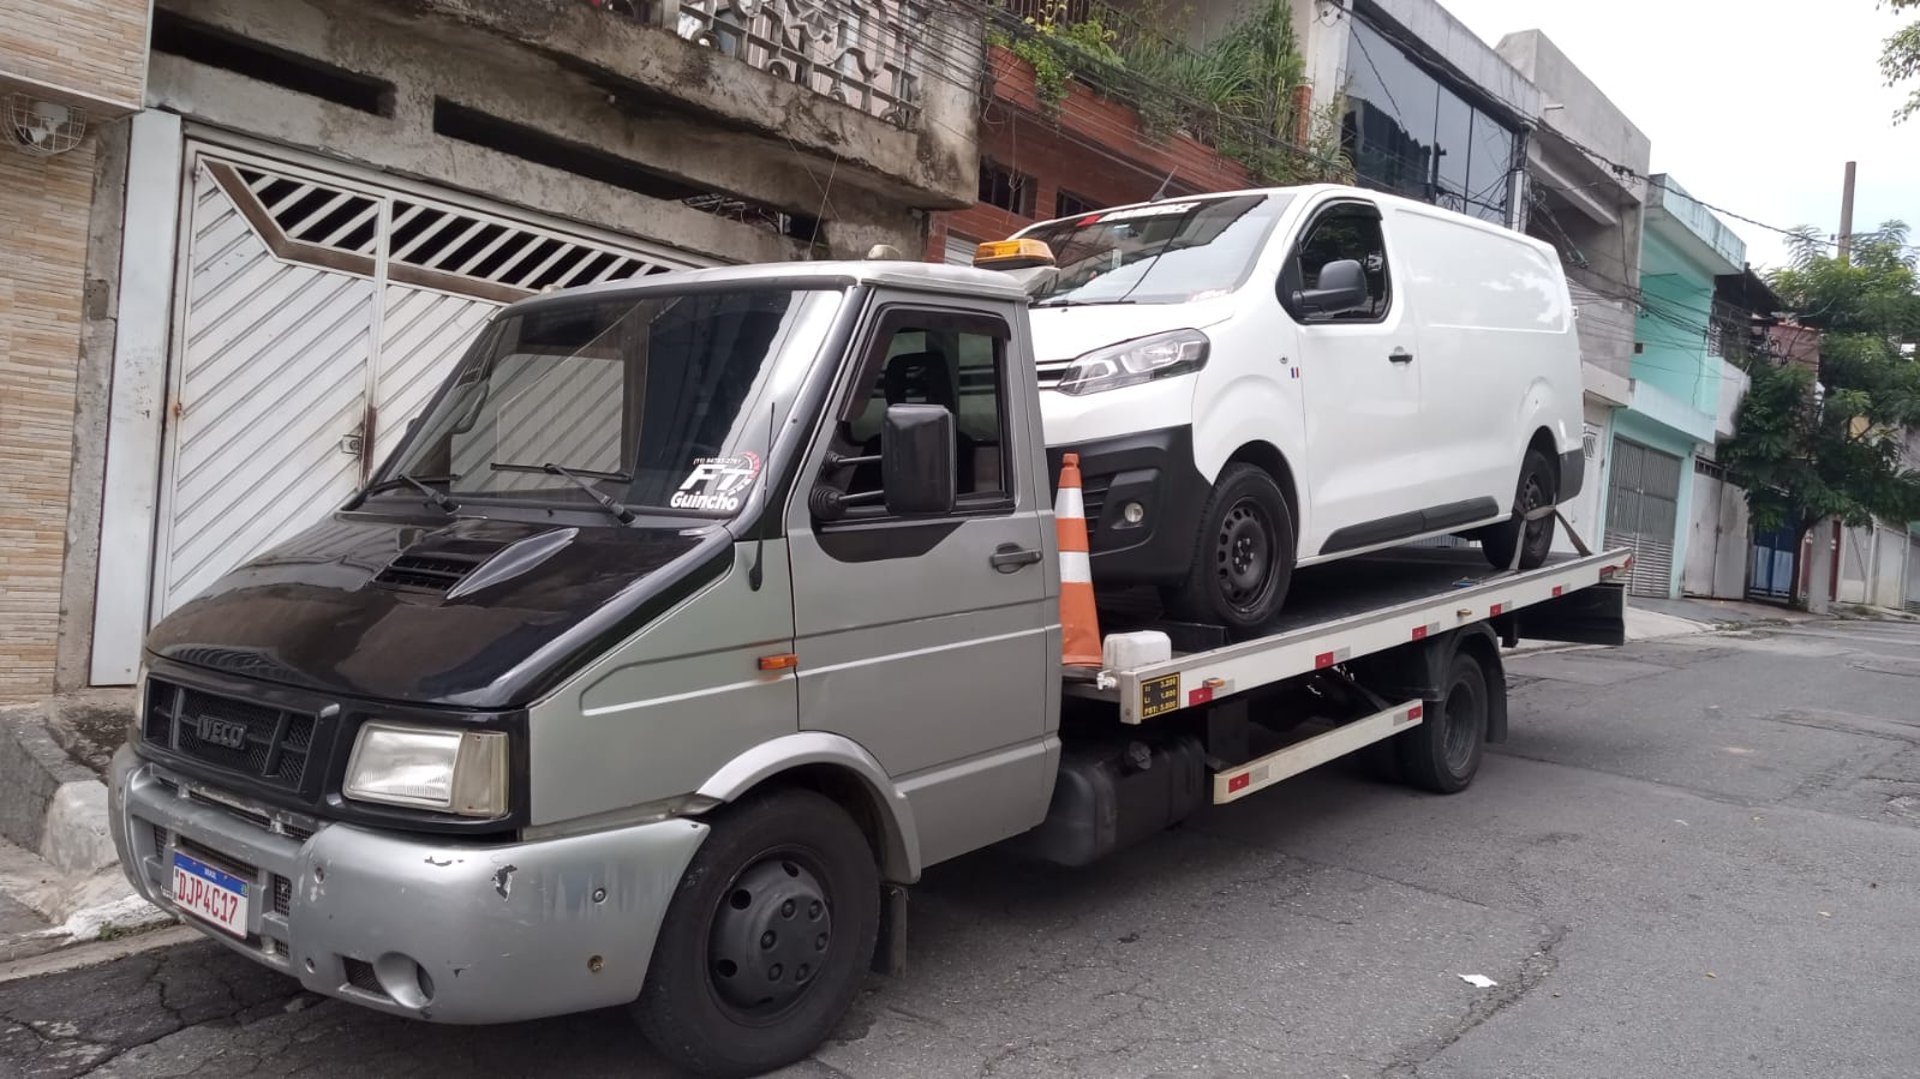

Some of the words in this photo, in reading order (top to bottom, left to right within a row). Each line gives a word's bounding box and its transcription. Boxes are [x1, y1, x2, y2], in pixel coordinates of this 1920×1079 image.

[679, 464, 754, 491] FT
[670, 491, 739, 511] Guincho
[197, 717, 244, 747] IVECO
[178, 872, 238, 925] DJP4C17
